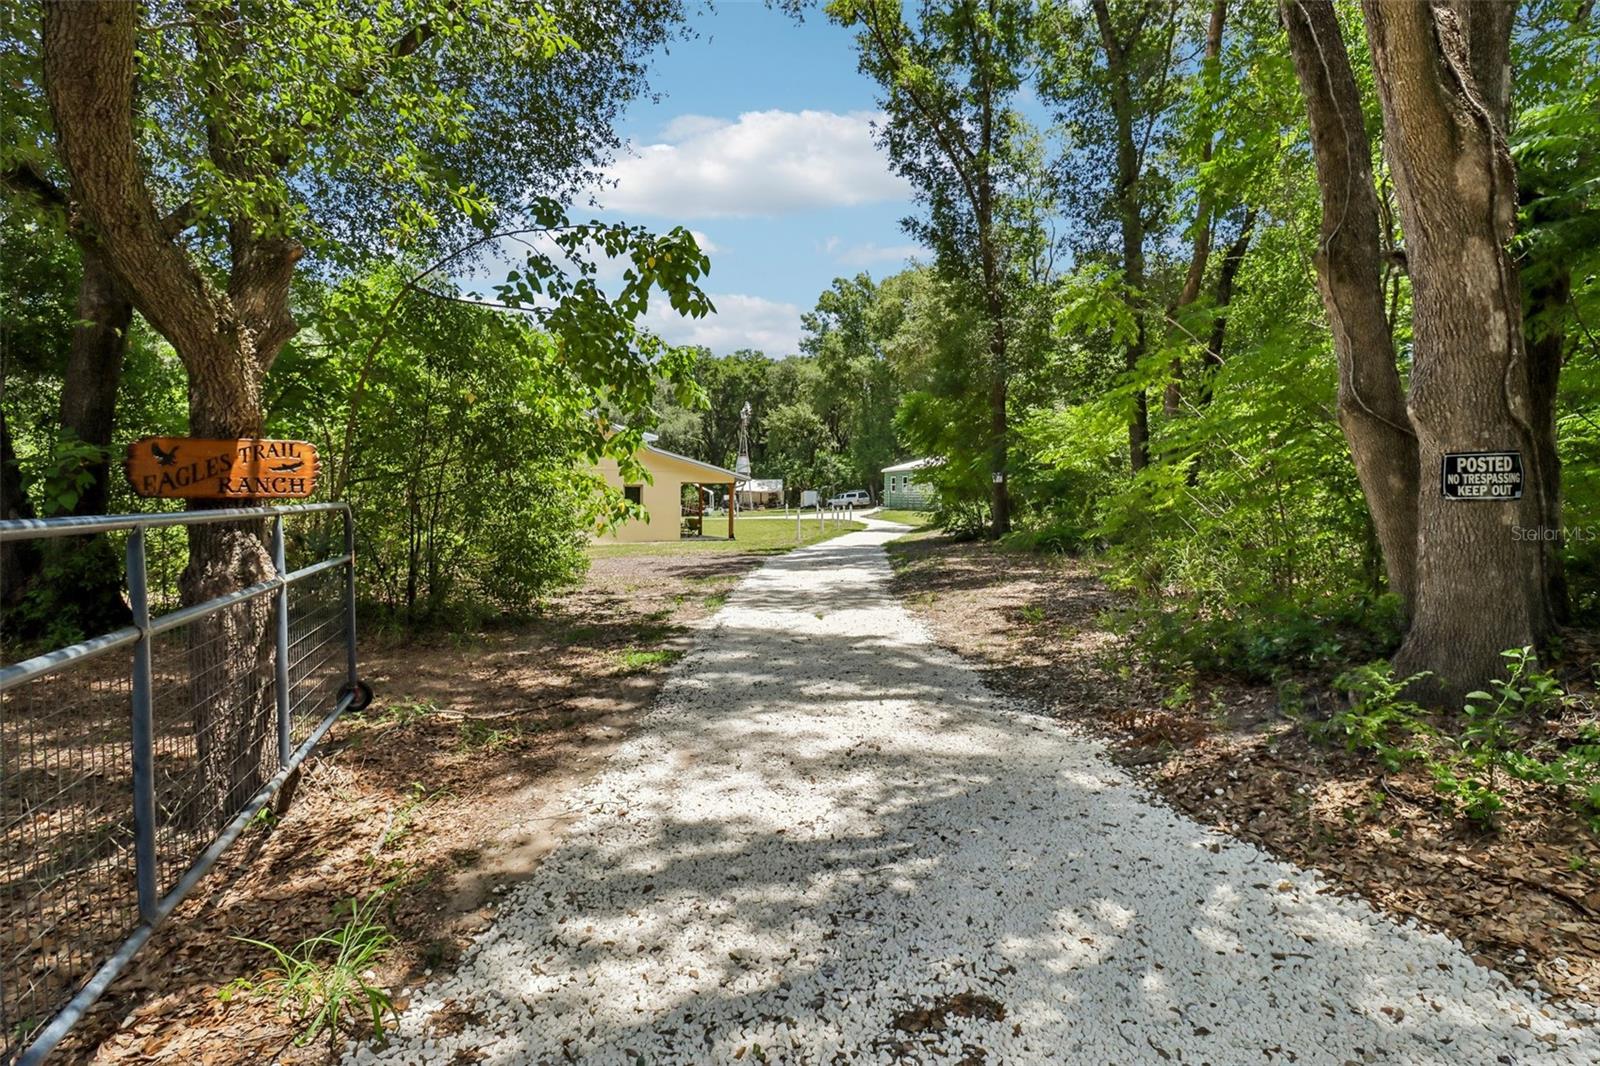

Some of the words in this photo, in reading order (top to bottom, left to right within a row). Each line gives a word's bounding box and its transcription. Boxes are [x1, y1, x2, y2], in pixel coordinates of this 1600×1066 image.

[143, 453, 233, 495] EAGLES
[239, 442, 301, 464] TRAIL
[1456, 456, 1513, 473] POSTED
[219, 476, 306, 494] RANCH
[1447, 474, 1460, 485] NO
[1462, 472, 1521, 485] TRESPASSING
[1457, 485, 1488, 496] KEEP
[1491, 485, 1512, 496] OUT
